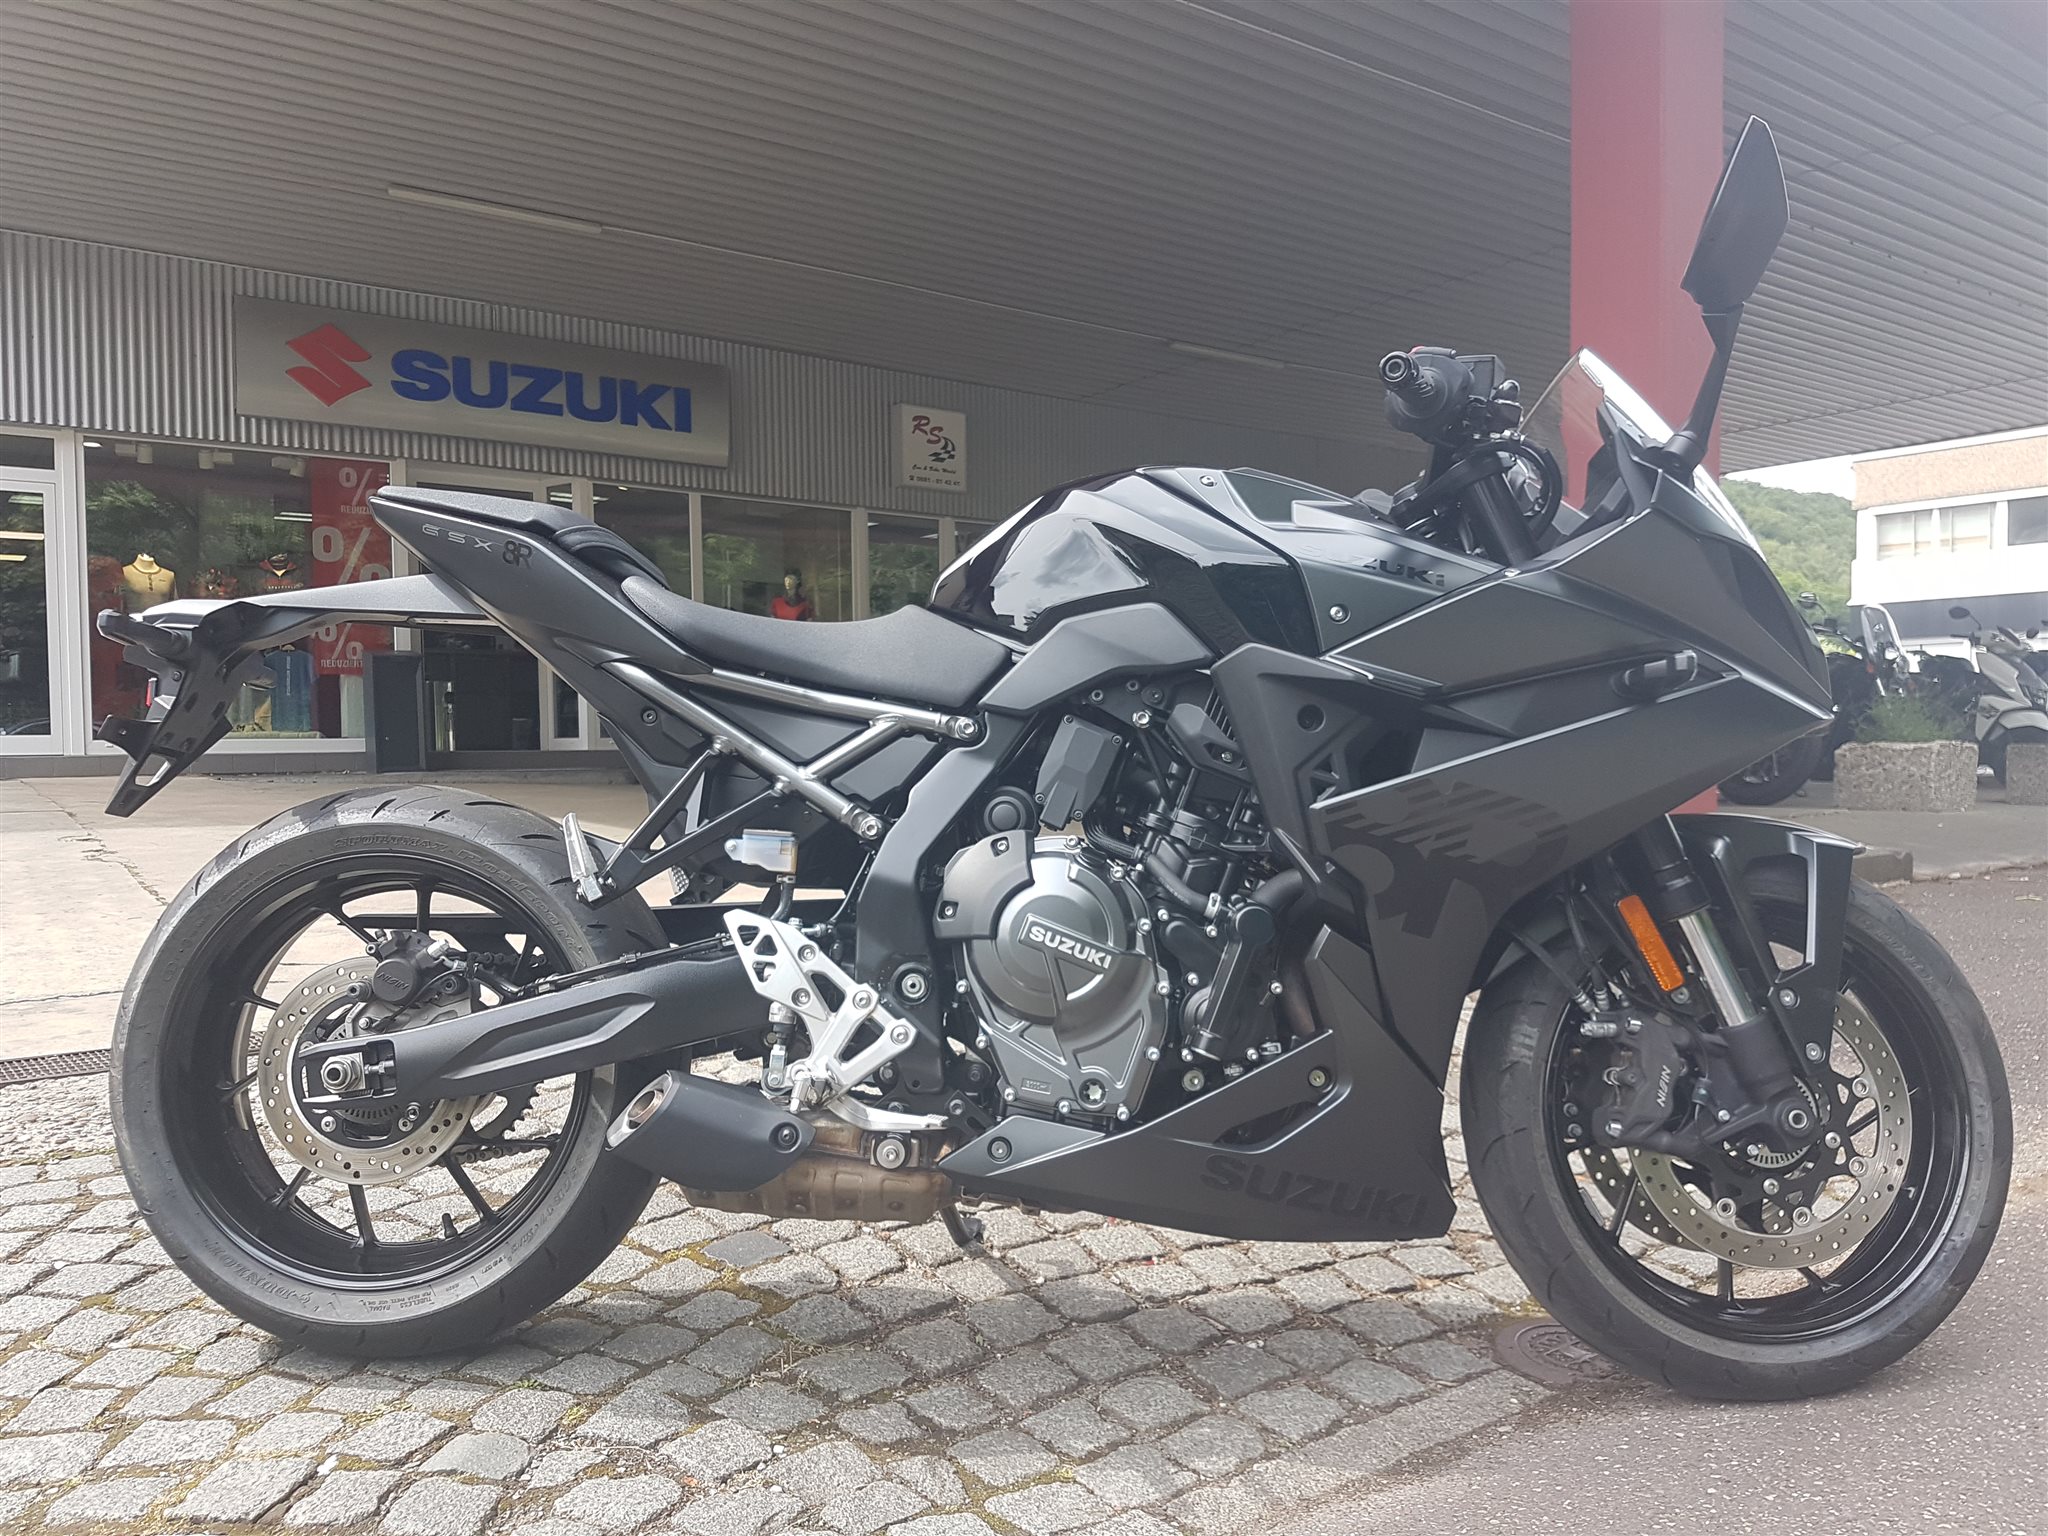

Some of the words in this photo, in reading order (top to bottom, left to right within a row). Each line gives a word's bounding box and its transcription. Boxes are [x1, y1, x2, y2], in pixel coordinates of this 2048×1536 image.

[390, 349, 692, 433] SUZUKI
[1028, 925, 1113, 970] SUZUKI
[1201, 1154, 1428, 1226] SUZUKI
